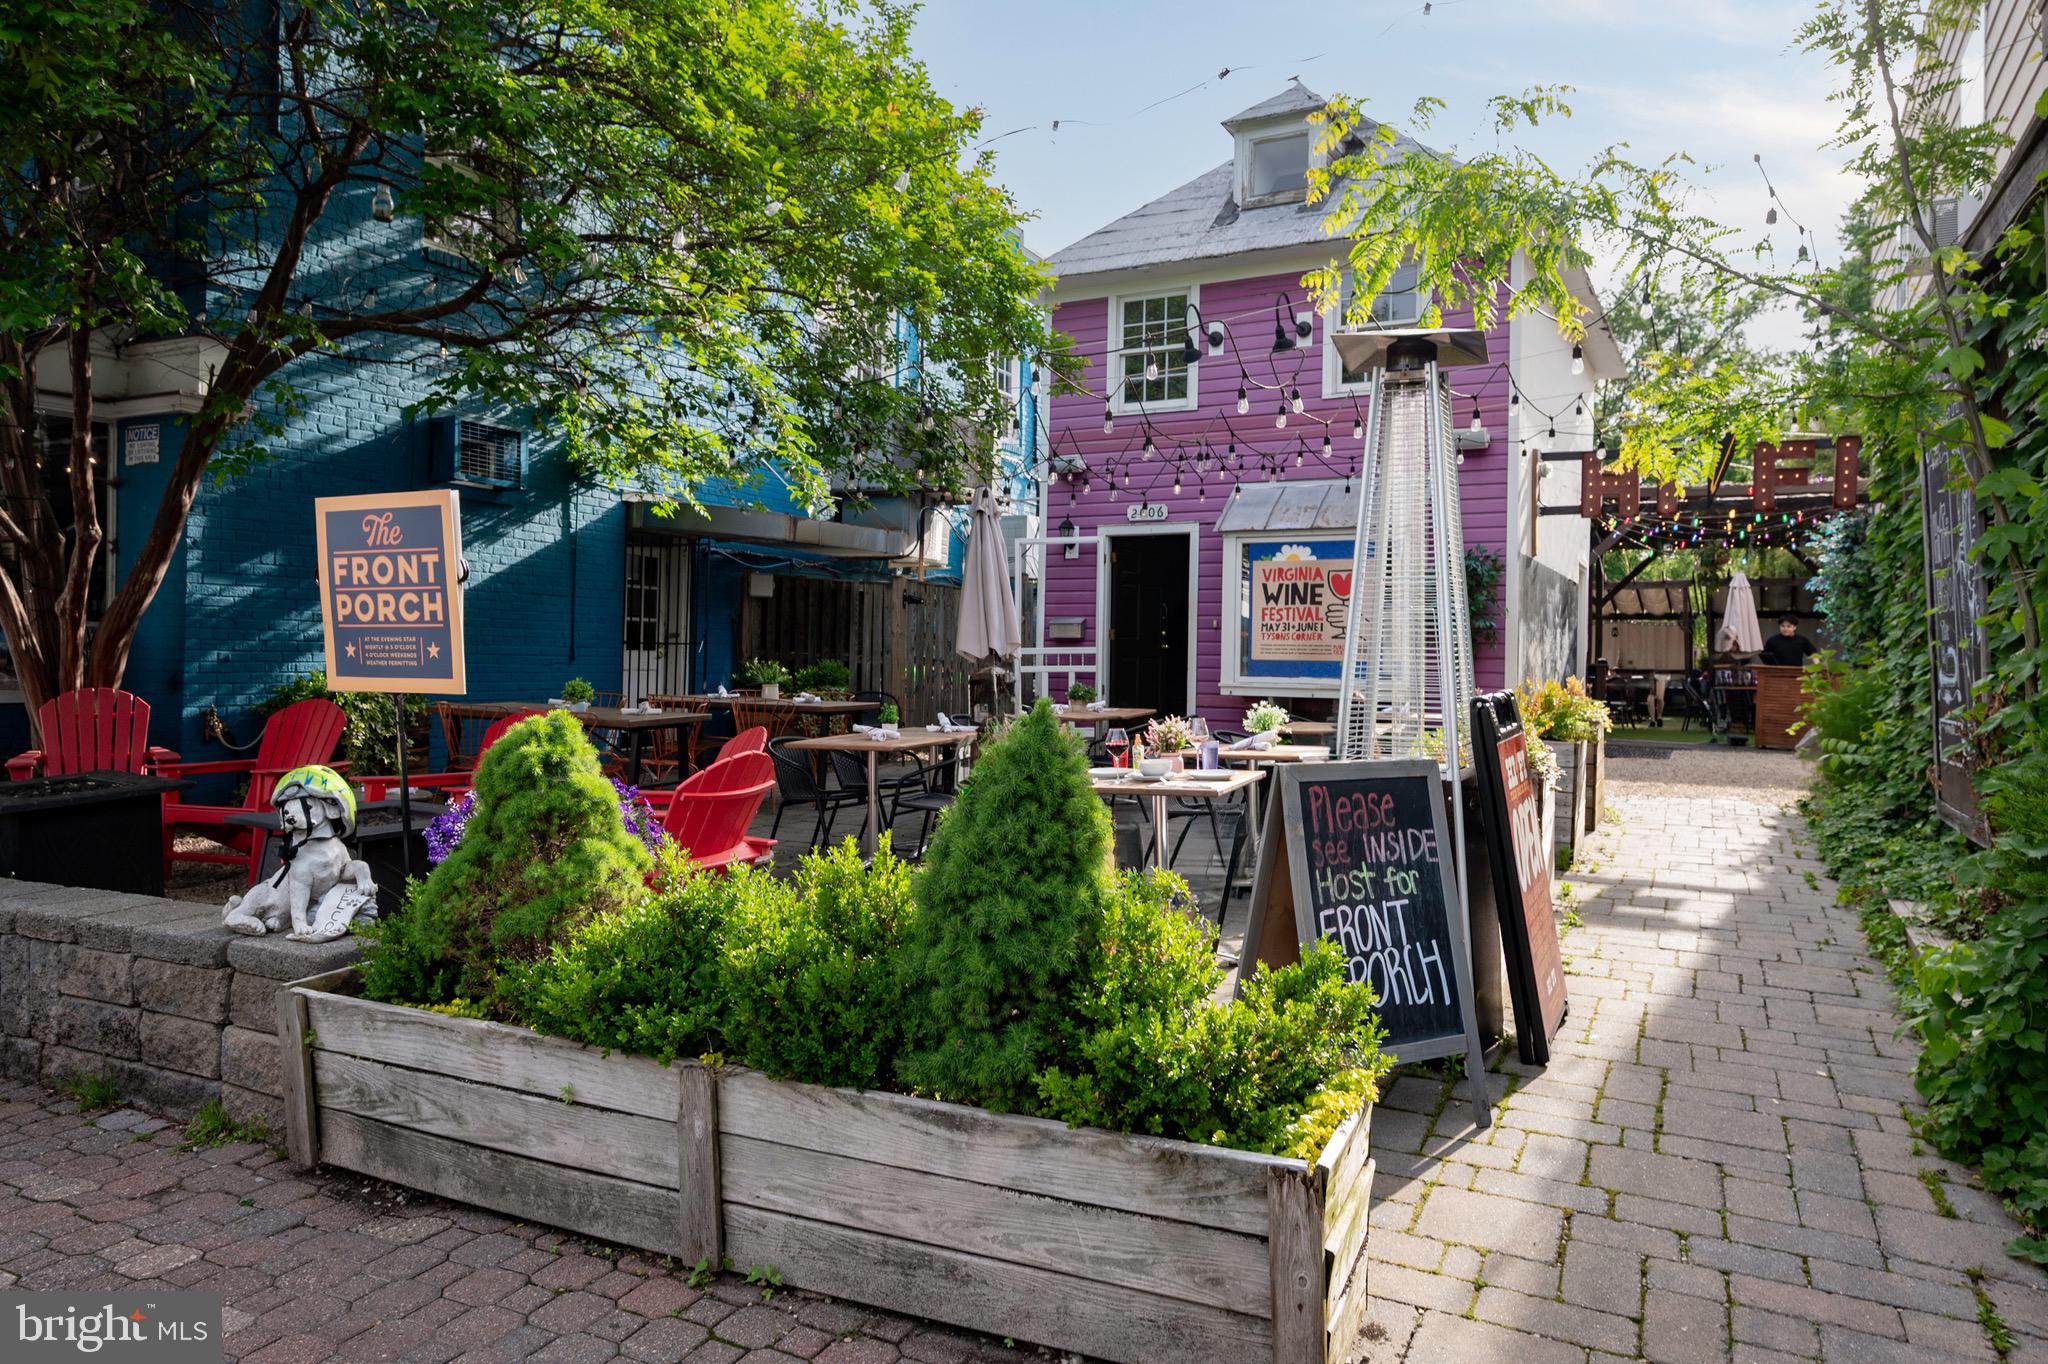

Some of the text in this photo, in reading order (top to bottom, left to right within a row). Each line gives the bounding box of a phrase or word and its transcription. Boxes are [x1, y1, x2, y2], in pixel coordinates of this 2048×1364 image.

[128, 428, 157, 441] NOTICE
[1131, 506, 1163, 518] 206
[362, 512, 403, 546] The
[333, 554, 439, 585] FRONT
[1262, 567, 1324, 582] VIRGINIA
[335, 592, 444, 622] PORCH
[1262, 583, 1324, 606] WINE
[1261, 606, 1324, 622] FESTIVAL
[1261, 622, 1280, 632] MAY
[1262, 632, 1323, 641] TYSONS CORNER
[1308, 785, 1396, 833] Please
[1363, 829, 1440, 866] INSIDE
[1512, 793, 1545, 893] OPEN
[1316, 861, 1419, 905] Host for
[323, 887, 357, 935] WELCO
[1319, 899, 1409, 955] FRONT
